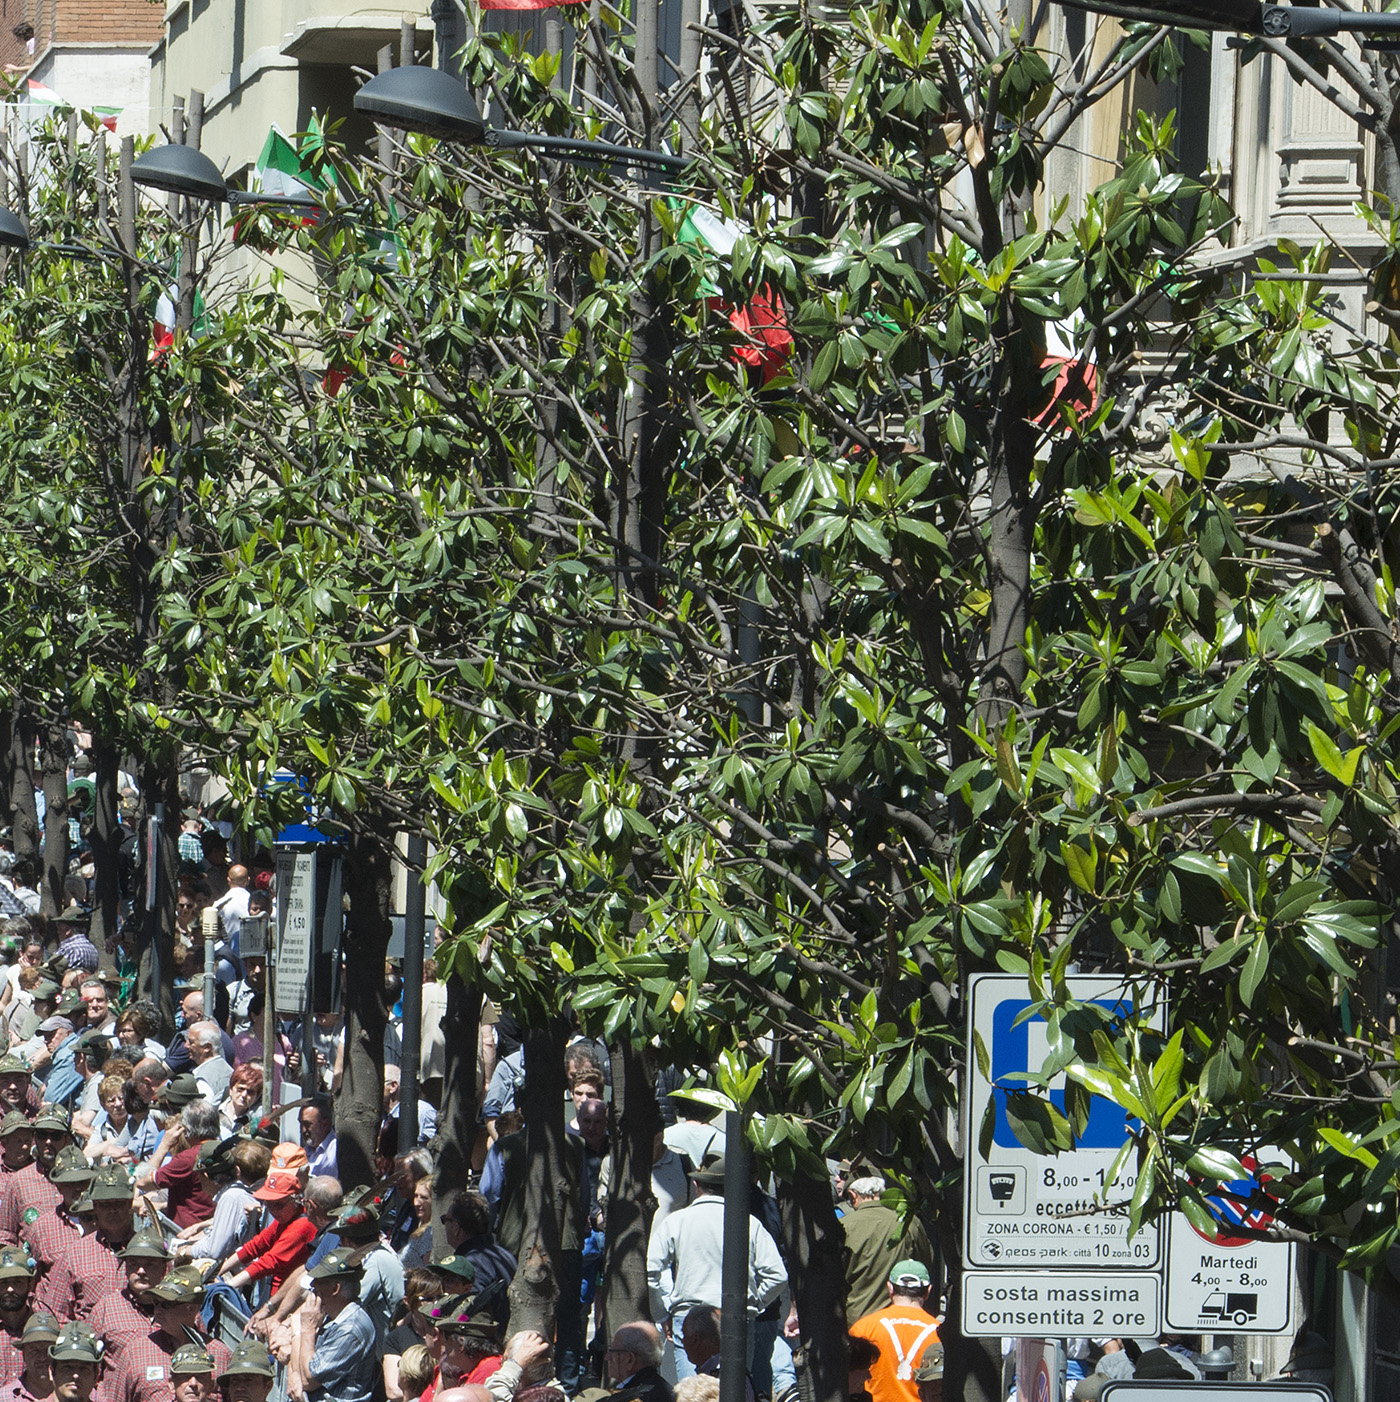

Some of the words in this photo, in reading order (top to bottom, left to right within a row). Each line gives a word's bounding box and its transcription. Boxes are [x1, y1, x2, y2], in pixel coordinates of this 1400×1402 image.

[1043, 1168, 1078, 1190] 8,00
[987, 1224, 1019, 1234] ZONA
[1023, 1223, 1074, 1234] CORONA
[1084, 1224, 1091, 1235] €
[1094, 1224, 1116, 1236] 1,50
[1094, 1244, 1109, 1257] 10
[1112, 1249, 1132, 1258] zona
[1134, 1244, 1150, 1258] 03
[1200, 1256, 1258, 1269] Martedi
[1191, 1272, 1220, 1287] 4,00
[1240, 1273, 1268, 1288] 8,00
[983, 1286, 1039, 1302] sosta
[1047, 1285, 1140, 1302] massima
[976, 1309, 1084, 1326] consentita
[1093, 1309, 1105, 1325] 2
[1111, 1313, 1146, 1326] ore
